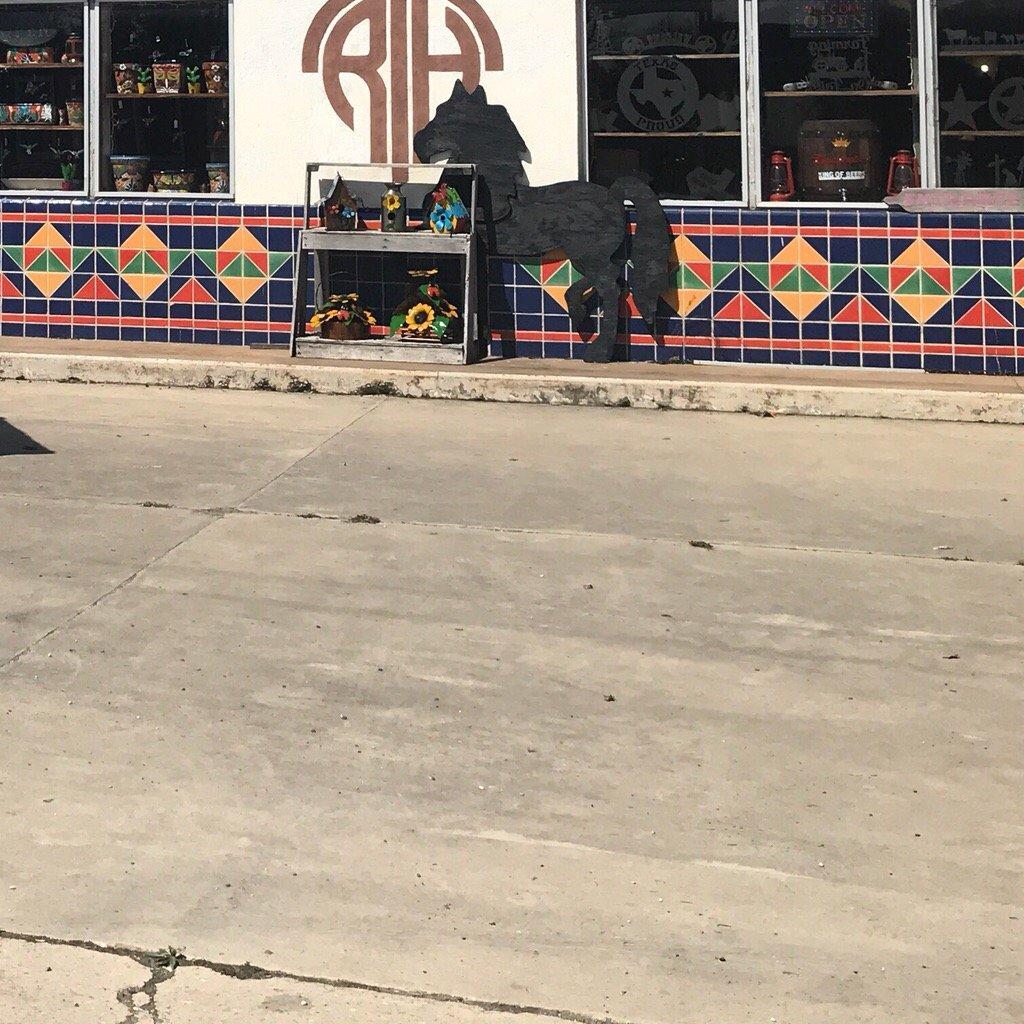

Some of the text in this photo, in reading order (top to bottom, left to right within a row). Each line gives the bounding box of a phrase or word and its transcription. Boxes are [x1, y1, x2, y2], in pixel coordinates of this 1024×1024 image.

[803, 14, 865, 28] OPEN
[634, 56, 679, 71] TEXAS
[637, 114, 685, 130] PROUD
[834, 171, 845, 180] OF
